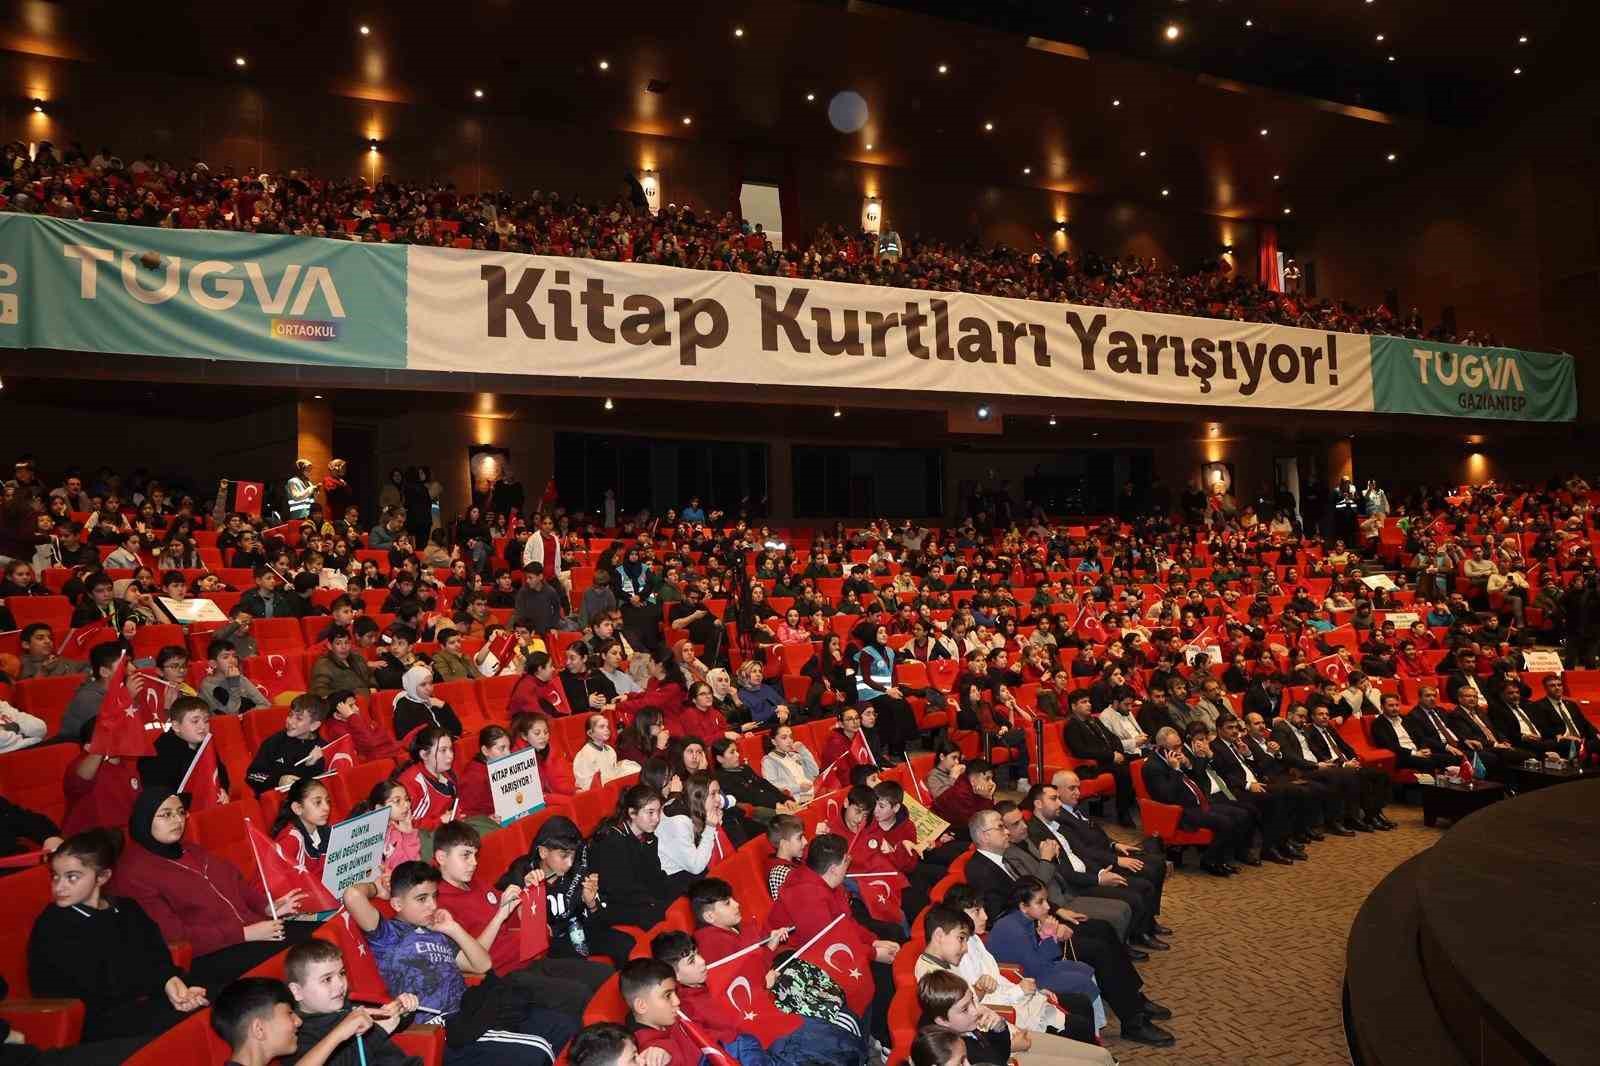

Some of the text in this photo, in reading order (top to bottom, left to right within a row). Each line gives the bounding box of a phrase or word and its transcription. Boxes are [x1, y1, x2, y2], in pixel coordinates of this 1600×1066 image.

[277, 323, 337, 337] ORTAOKUL
[480, 264, 1340, 396] Kitap Kurtları Yarışıyor!
